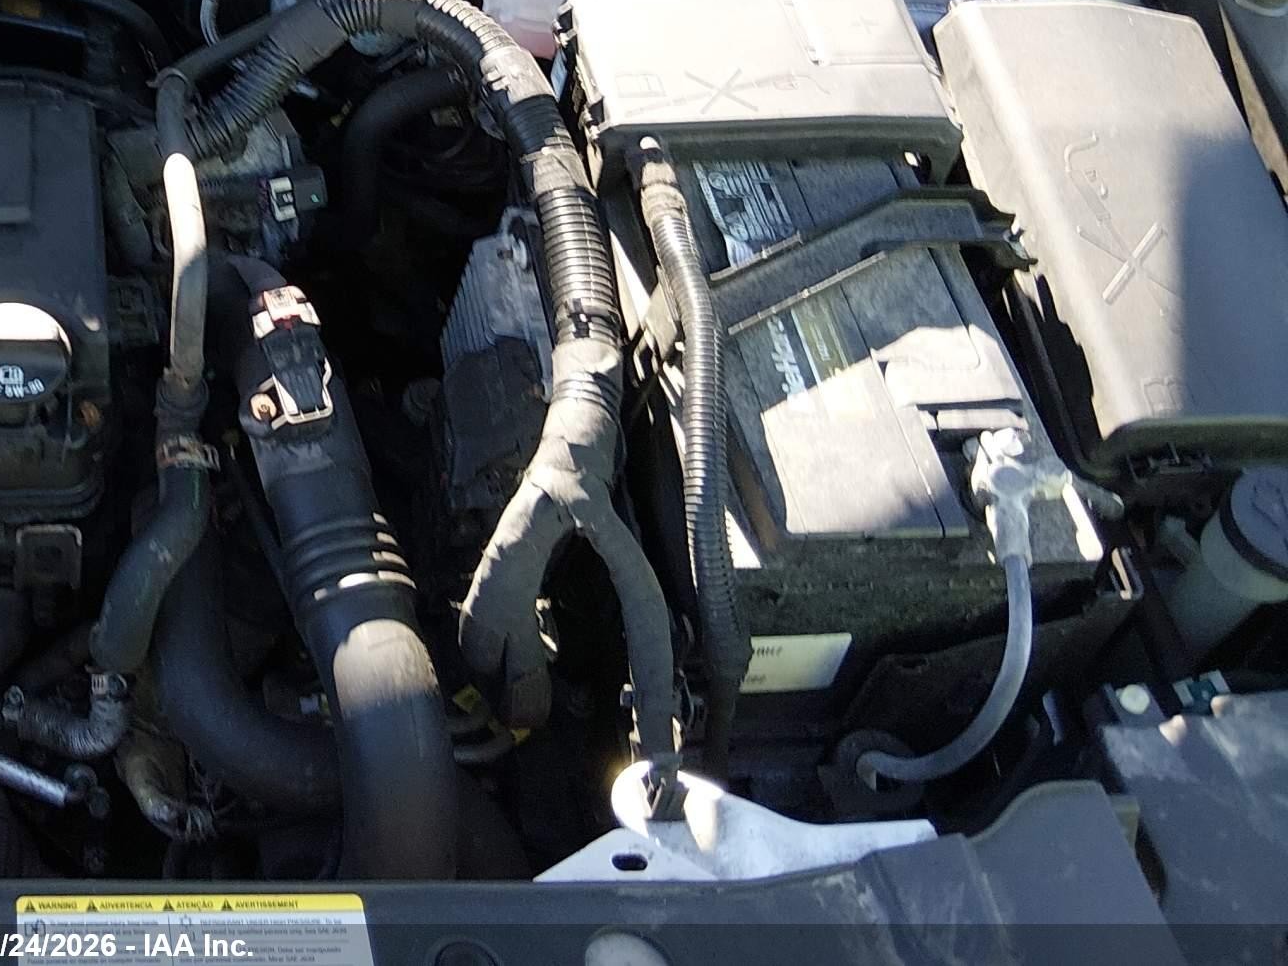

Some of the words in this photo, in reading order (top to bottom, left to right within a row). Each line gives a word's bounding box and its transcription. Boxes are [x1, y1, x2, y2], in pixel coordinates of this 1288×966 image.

[38, 900, 78, 910] WARNING
[100, 900, 153, 910] ADVERTENCIA
[235, 899, 298, 910] AVERTISSEMENT
